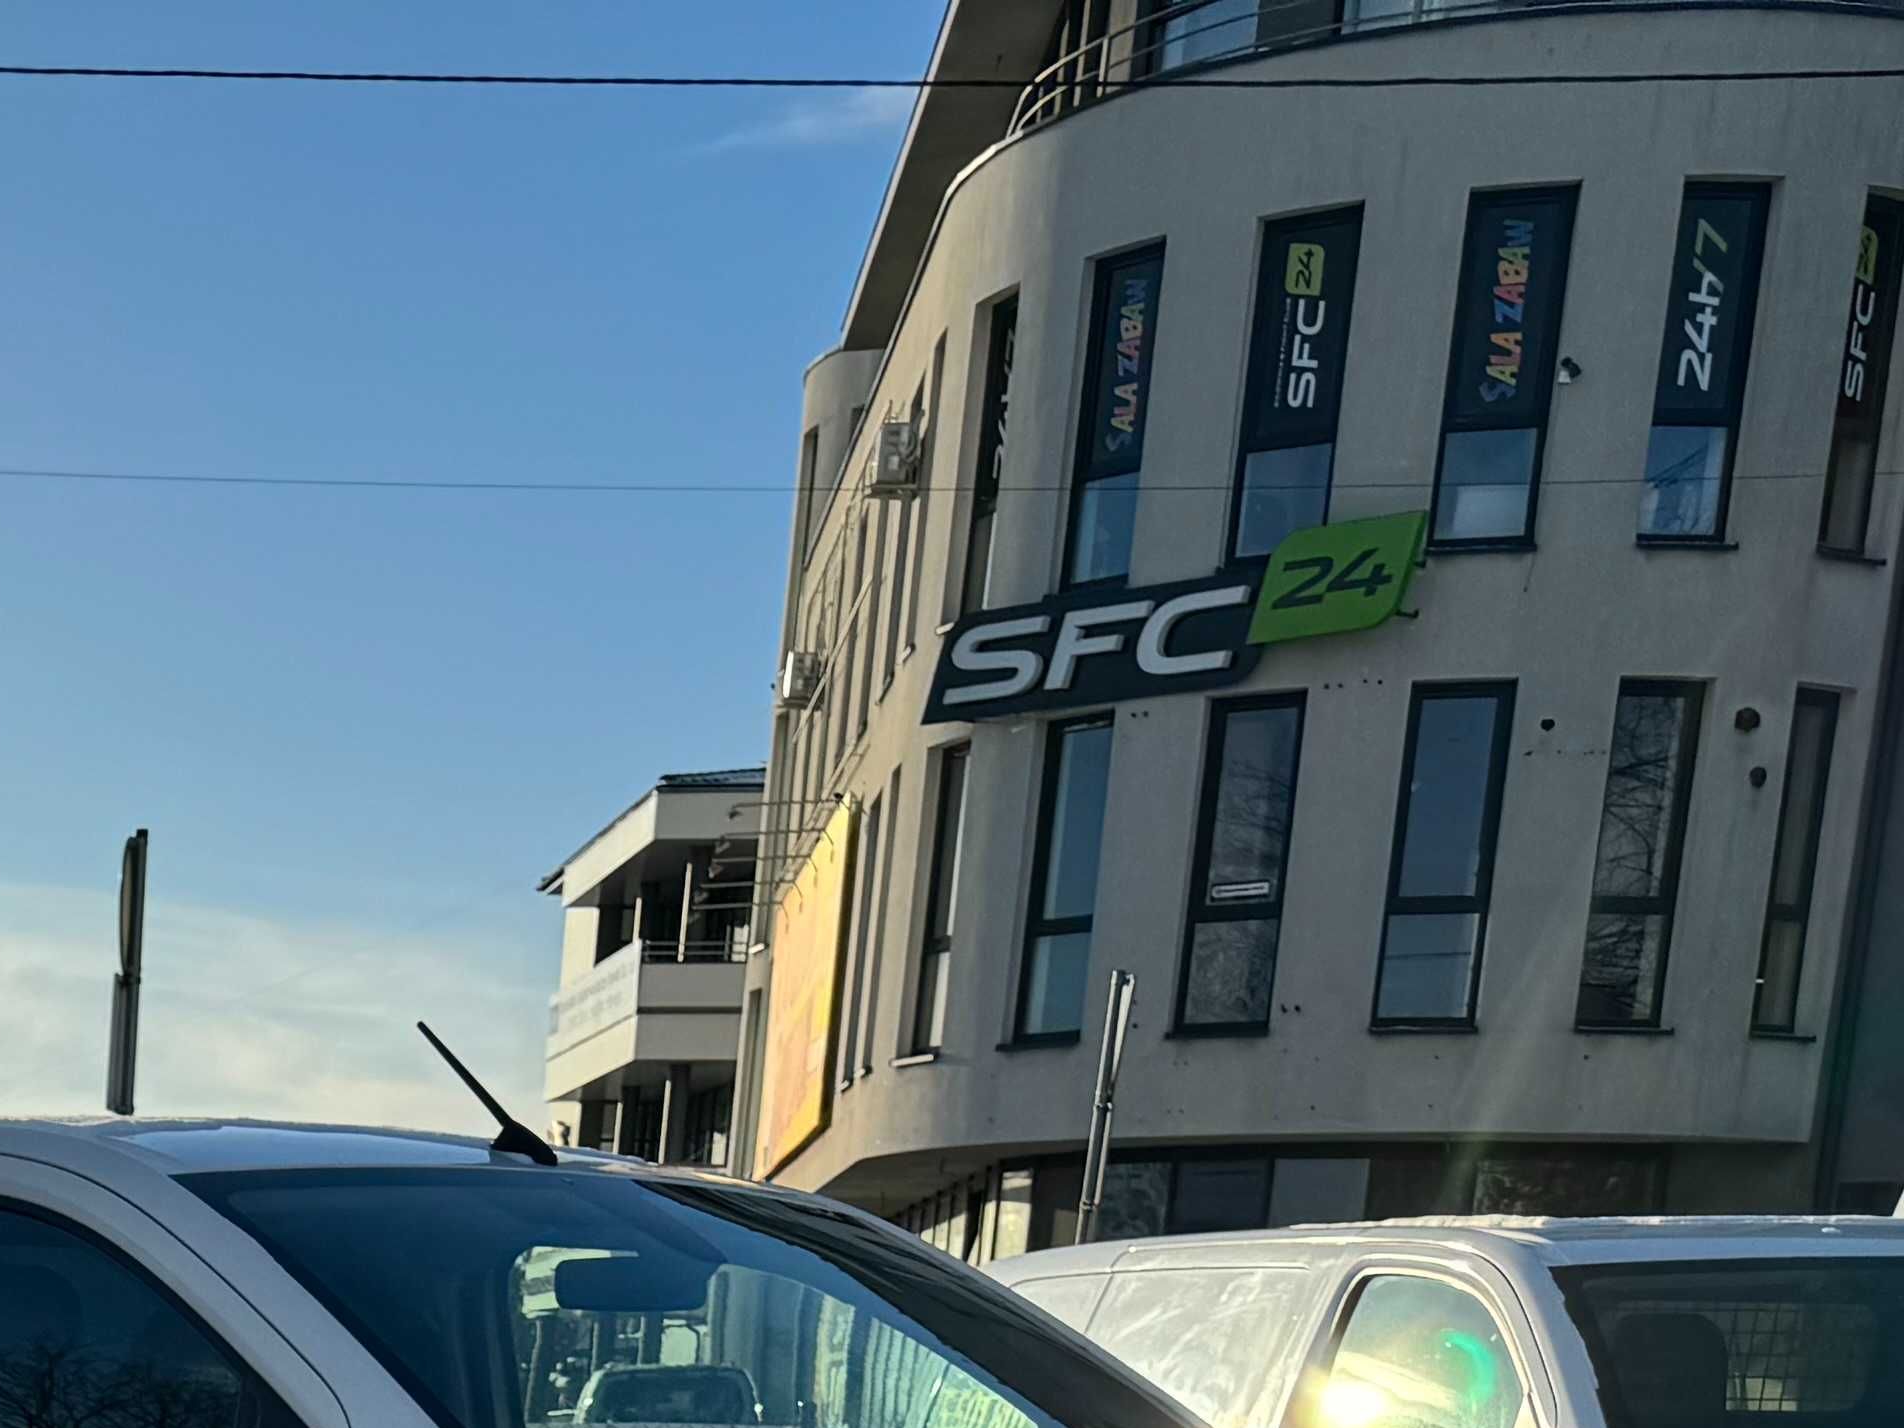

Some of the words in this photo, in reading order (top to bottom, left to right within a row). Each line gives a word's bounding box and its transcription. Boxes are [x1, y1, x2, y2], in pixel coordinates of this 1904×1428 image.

[1295, 248, 1315, 289] 24
[1493, 219, 1535, 323] ZABAW
[1116, 279, 1149, 376] ZABAW
[1287, 298, 1326, 408] SFC
[1479, 331, 1523, 402] SALA
[1844, 284, 1876, 401] SFC
[1105, 383, 1139, 450] SALA
[943, 585, 1251, 704] SFC
[1272, 548, 1394, 610] 24
